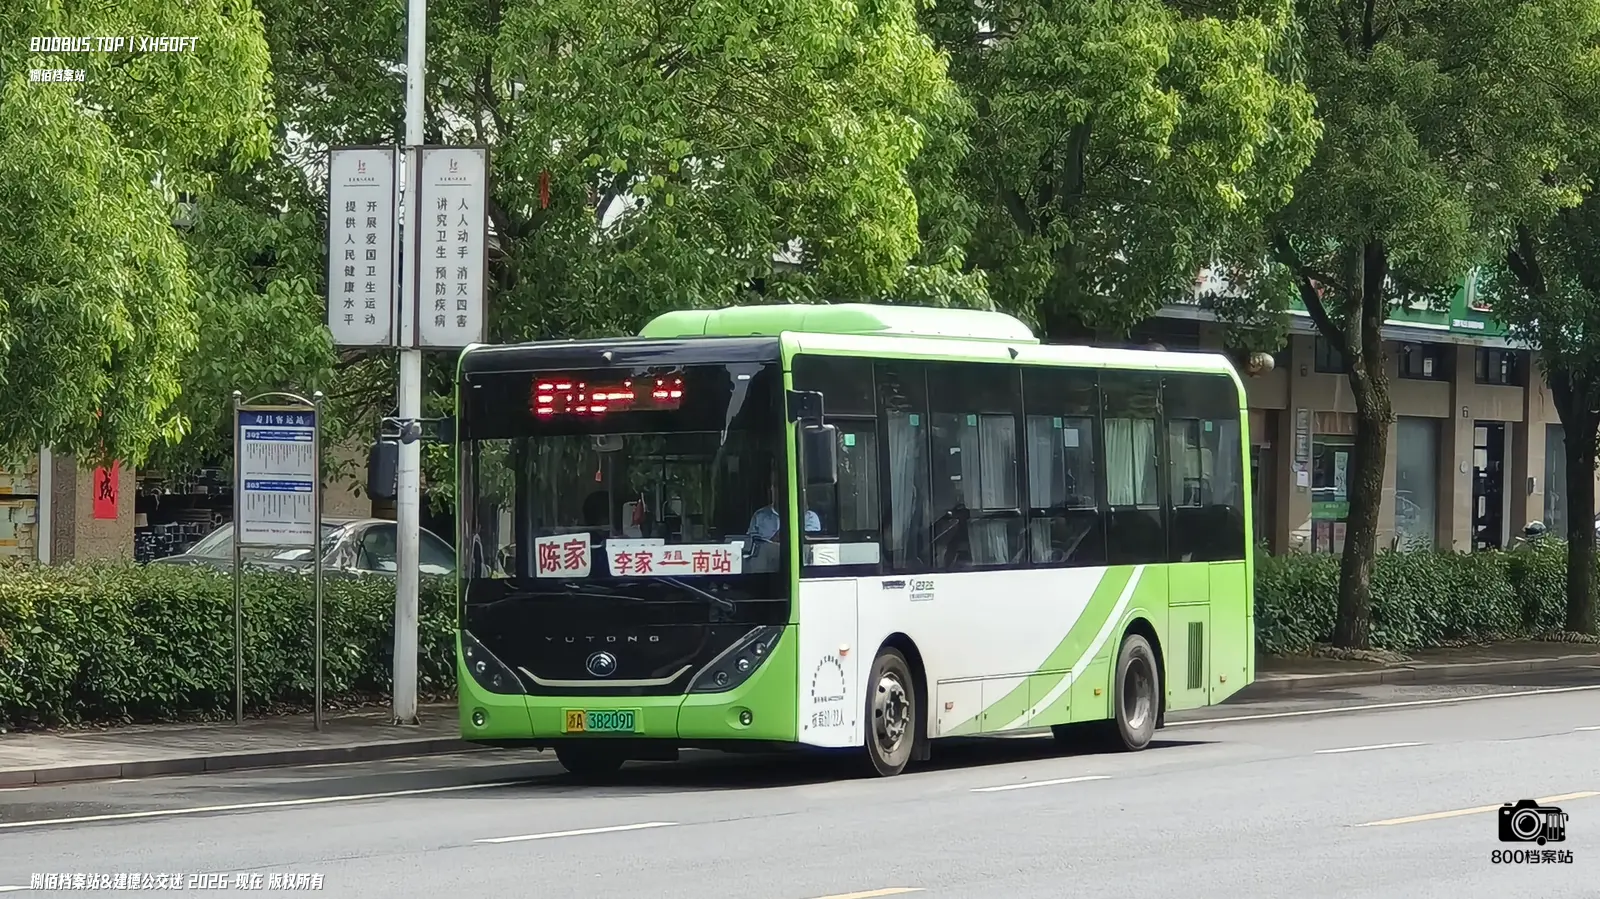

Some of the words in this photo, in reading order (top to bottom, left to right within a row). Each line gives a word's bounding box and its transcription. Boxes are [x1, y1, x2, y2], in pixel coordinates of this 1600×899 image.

[435, 197, 448, 259] 讲究卫生
[457, 197, 469, 259] 人人动手
[343, 201, 357, 326] 提供人民健康水平
[364, 201, 378, 325] 开展爱国卫生运动
[434, 266, 447, 328] 预防疾病
[456, 266, 468, 328] 消灭四害
[538, 538, 588, 575] 陈家
[613, 550, 653, 575] 李家
[691, 549, 732, 573] 南站
[545, 635, 660, 643] YUTONG
[588, 713, 634, 729] 38209D
